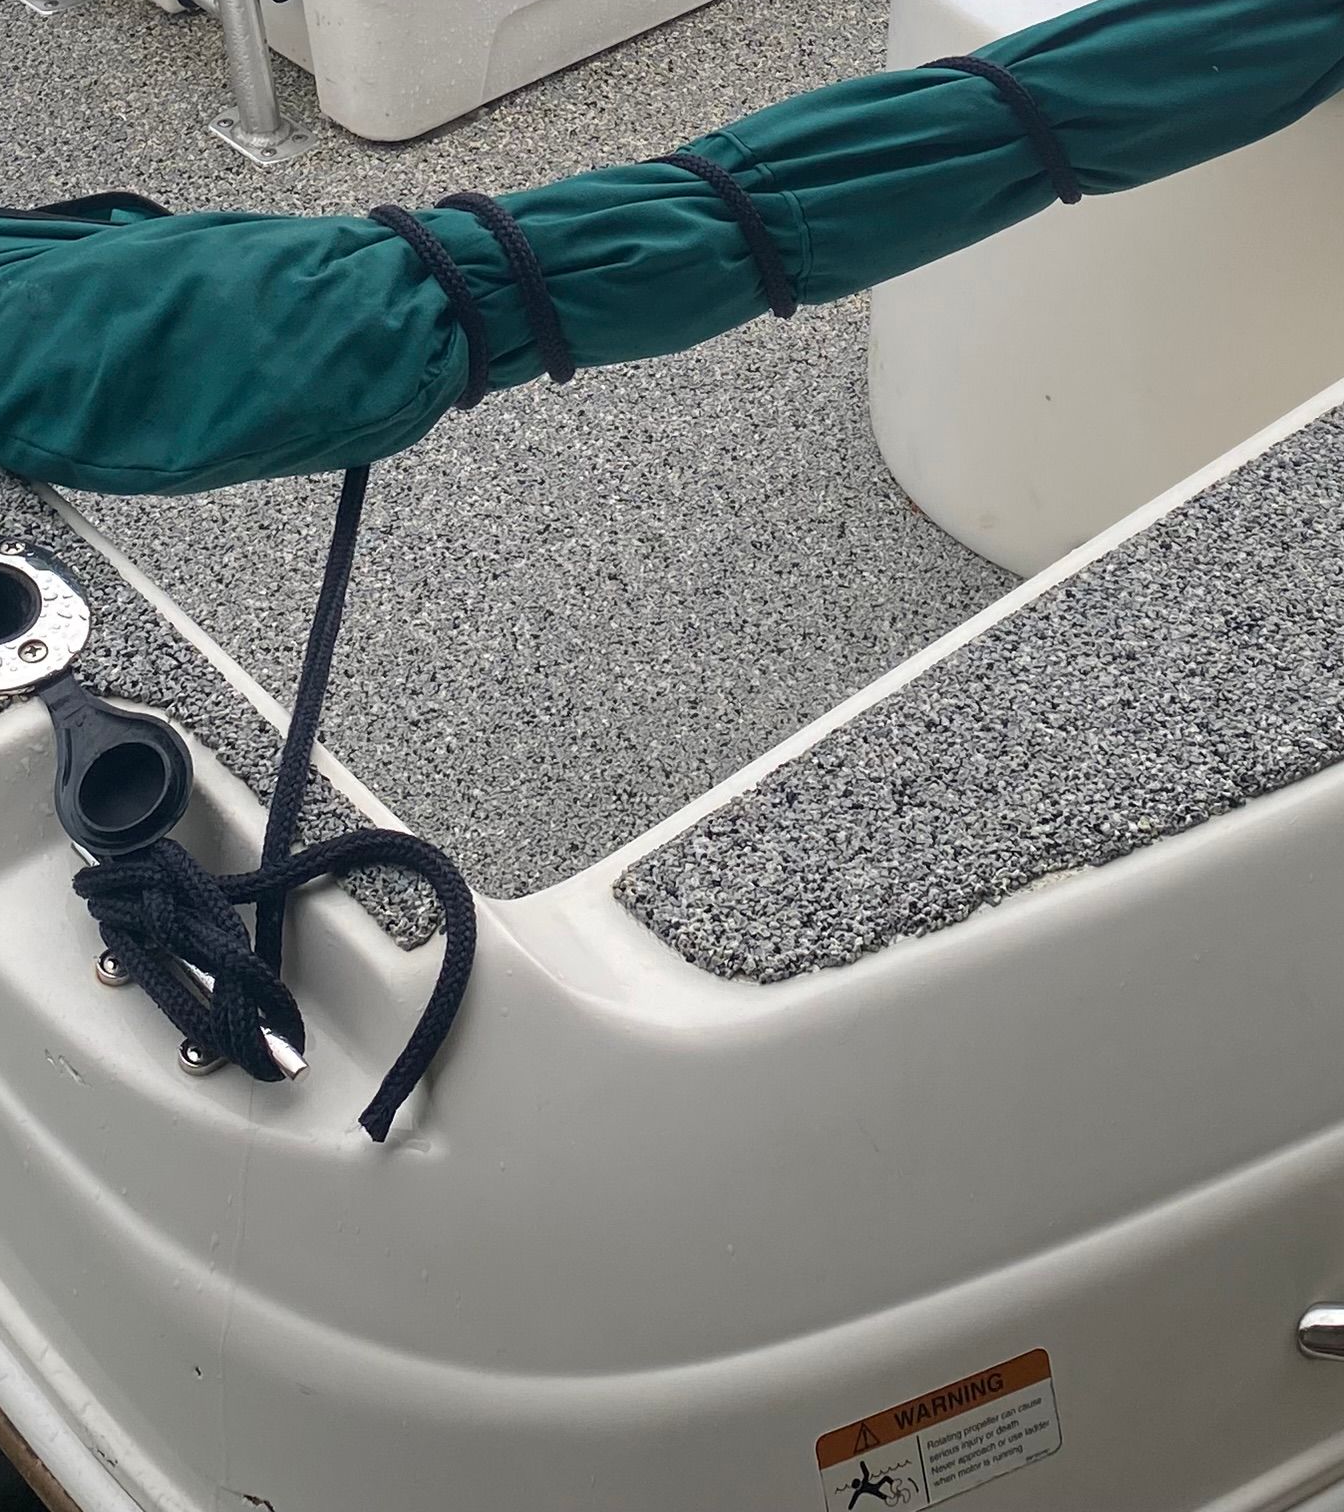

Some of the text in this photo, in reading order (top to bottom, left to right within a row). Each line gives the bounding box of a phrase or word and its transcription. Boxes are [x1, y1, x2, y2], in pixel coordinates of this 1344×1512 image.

[894, 1372, 1004, 1430] WARNING
[927, 1396, 1042, 1451] Rotating propeller can cause
[929, 1419, 1019, 1462] serious injury or death
[931, 1419, 1050, 1476] Never approach or use ladder
[933, 1472, 957, 1488] when
[958, 1462, 982, 1478] motor
[983, 1456, 991, 1468] is
[992, 1445, 1024, 1463] running
